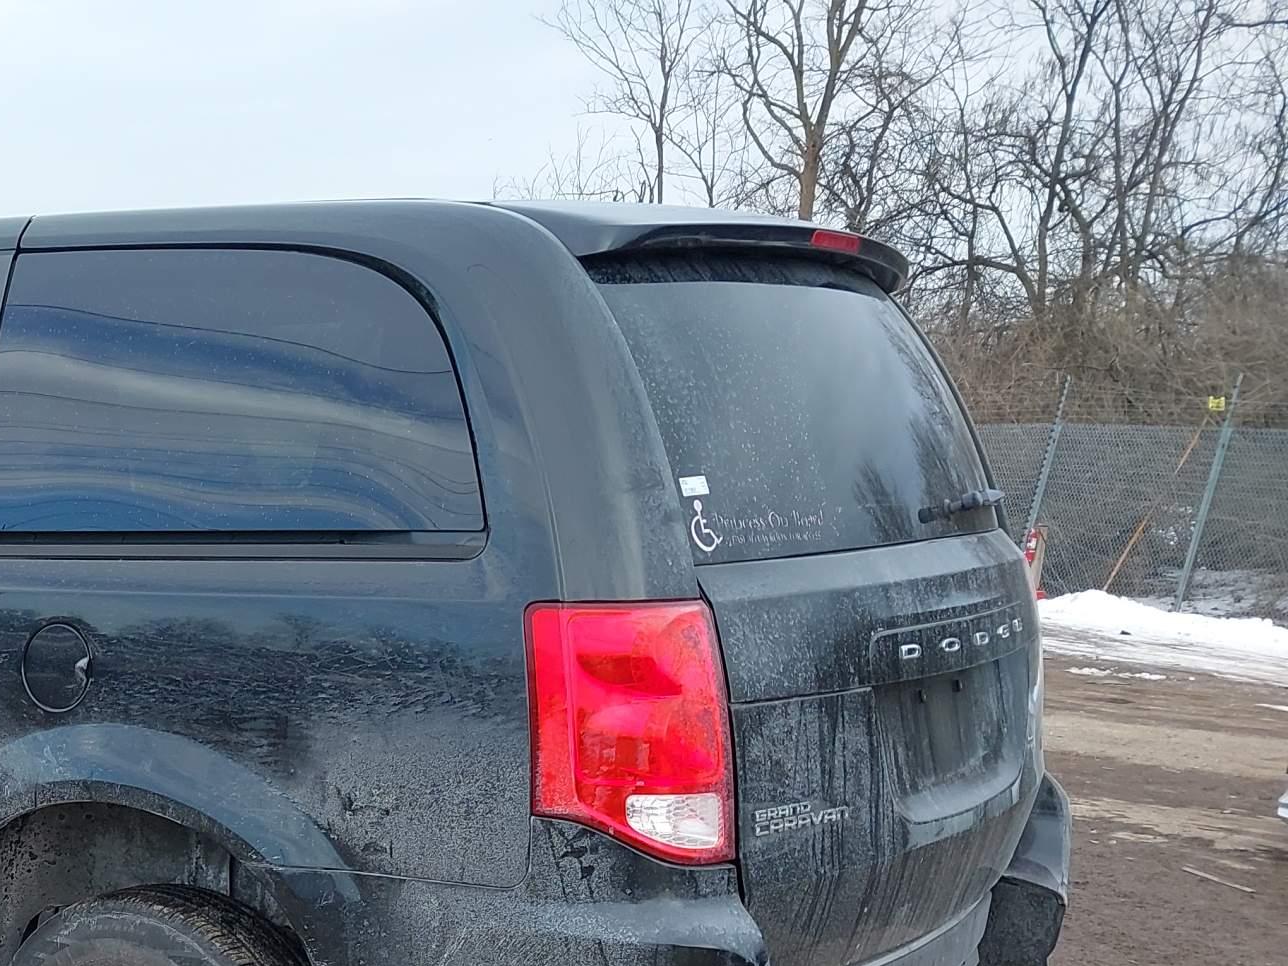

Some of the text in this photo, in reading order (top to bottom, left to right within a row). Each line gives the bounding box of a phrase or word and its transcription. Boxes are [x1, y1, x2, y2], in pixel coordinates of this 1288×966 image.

[899, 618, 1024, 660] DODGE
[755, 802, 811, 822] GRAND
[755, 807, 849, 836] CARAVAN
